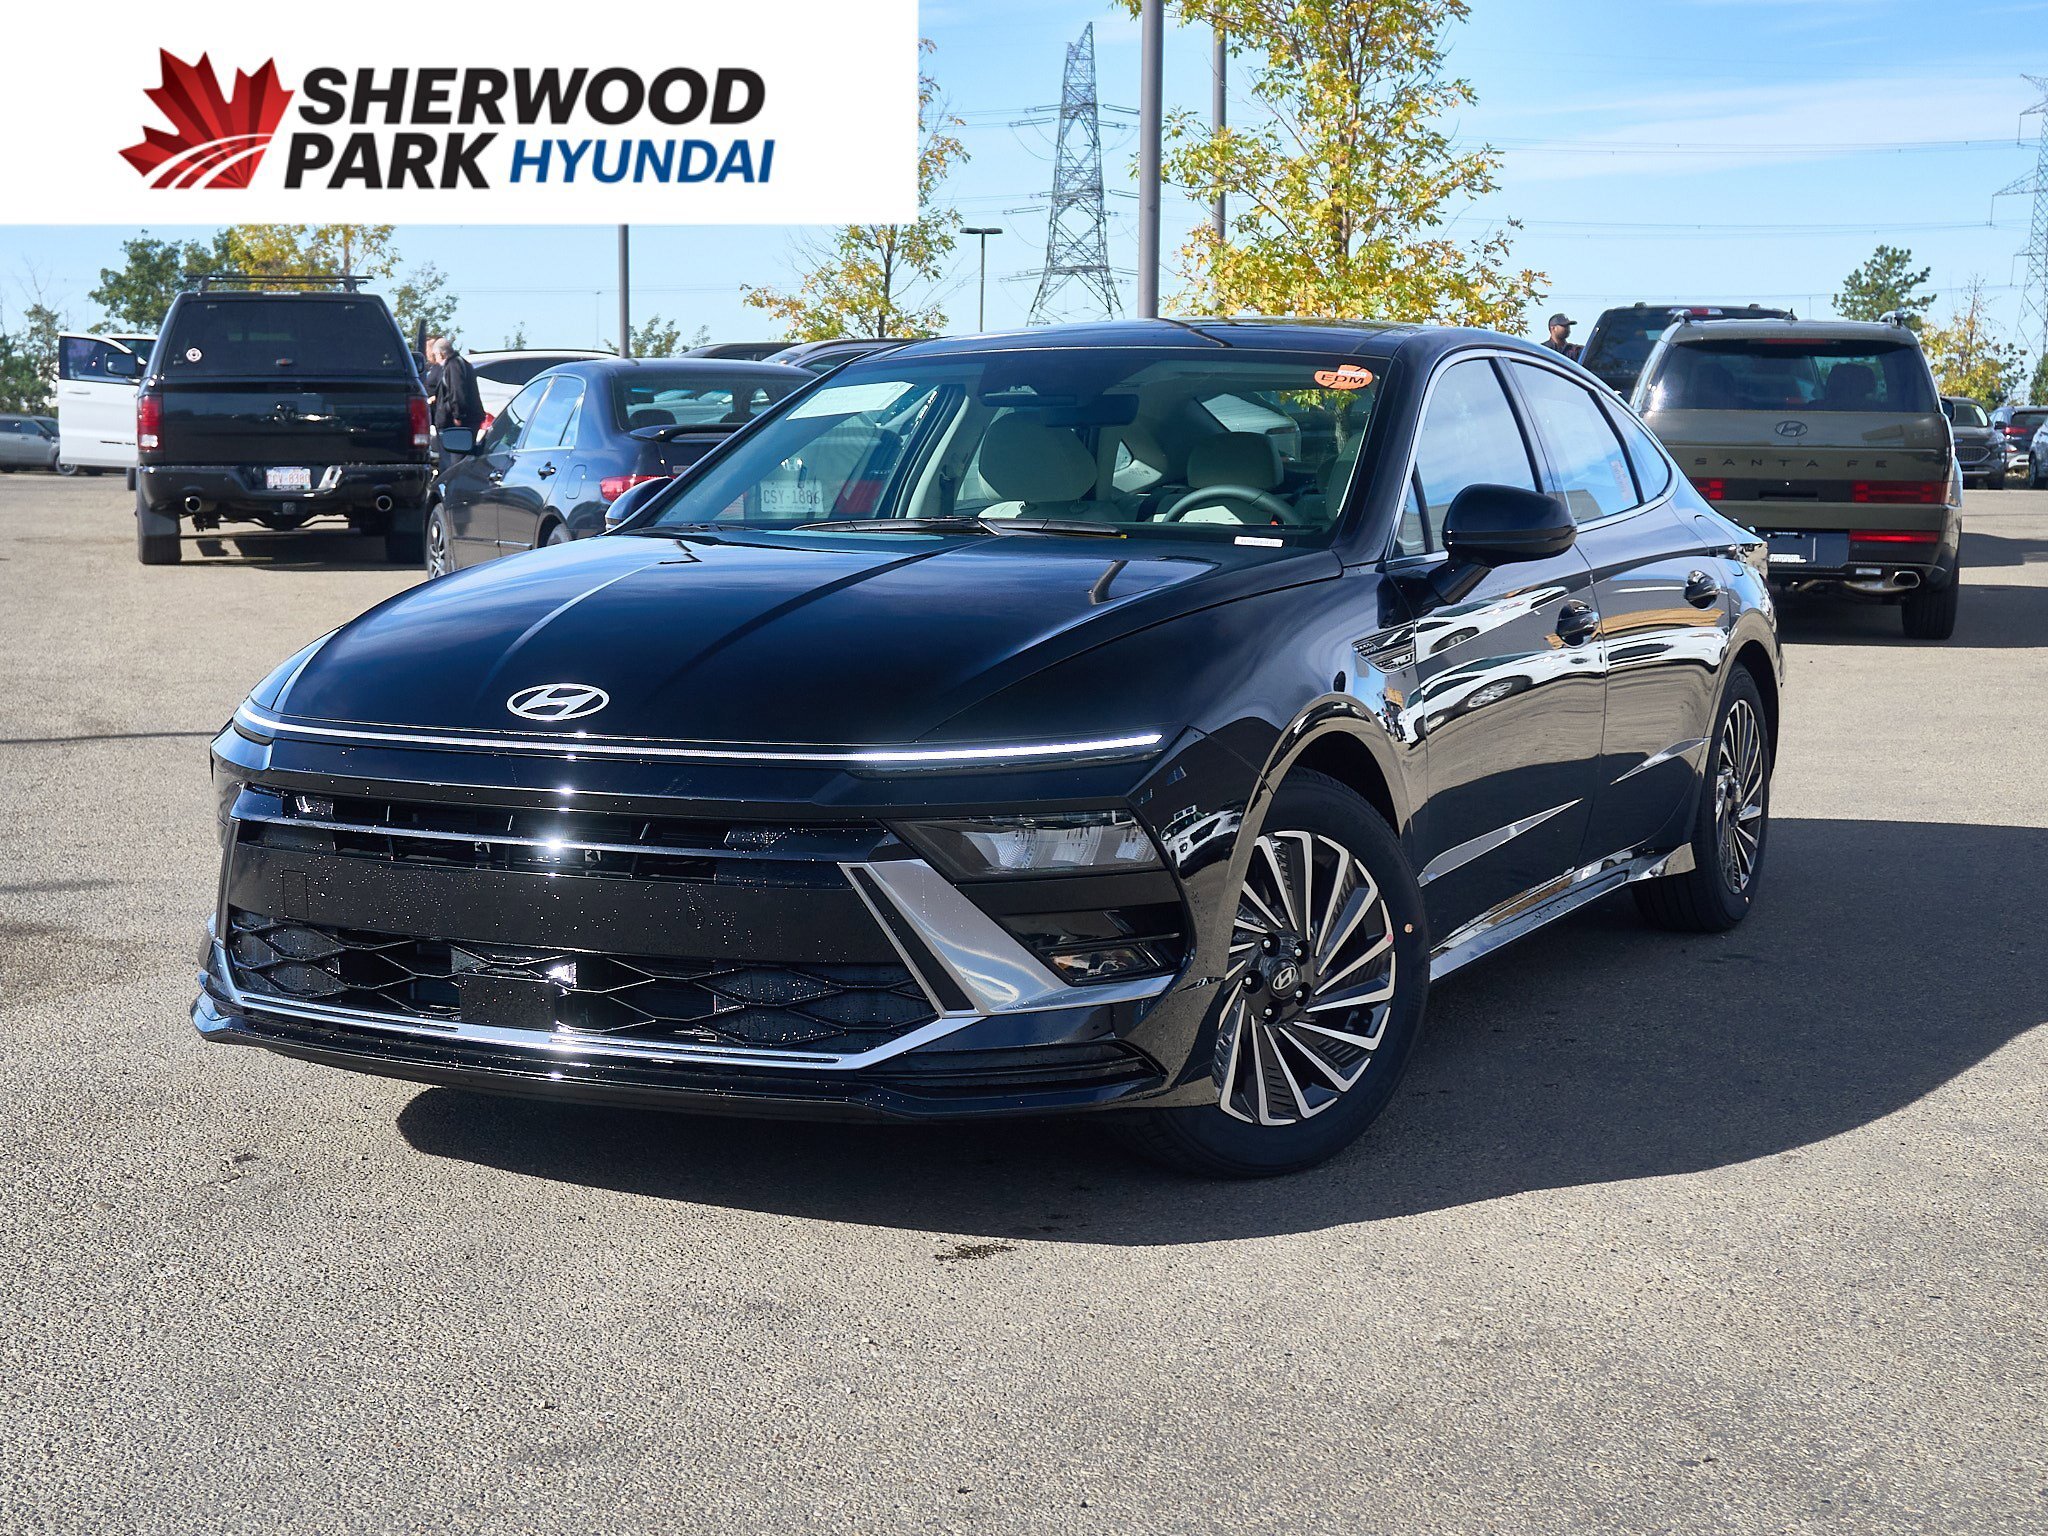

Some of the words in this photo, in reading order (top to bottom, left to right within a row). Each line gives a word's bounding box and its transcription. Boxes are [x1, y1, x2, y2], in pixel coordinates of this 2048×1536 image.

[1321, 374, 1364, 385] EDM
[1695, 457, 1819, 468] SANTA
[1847, 459, 1887, 469] FE
